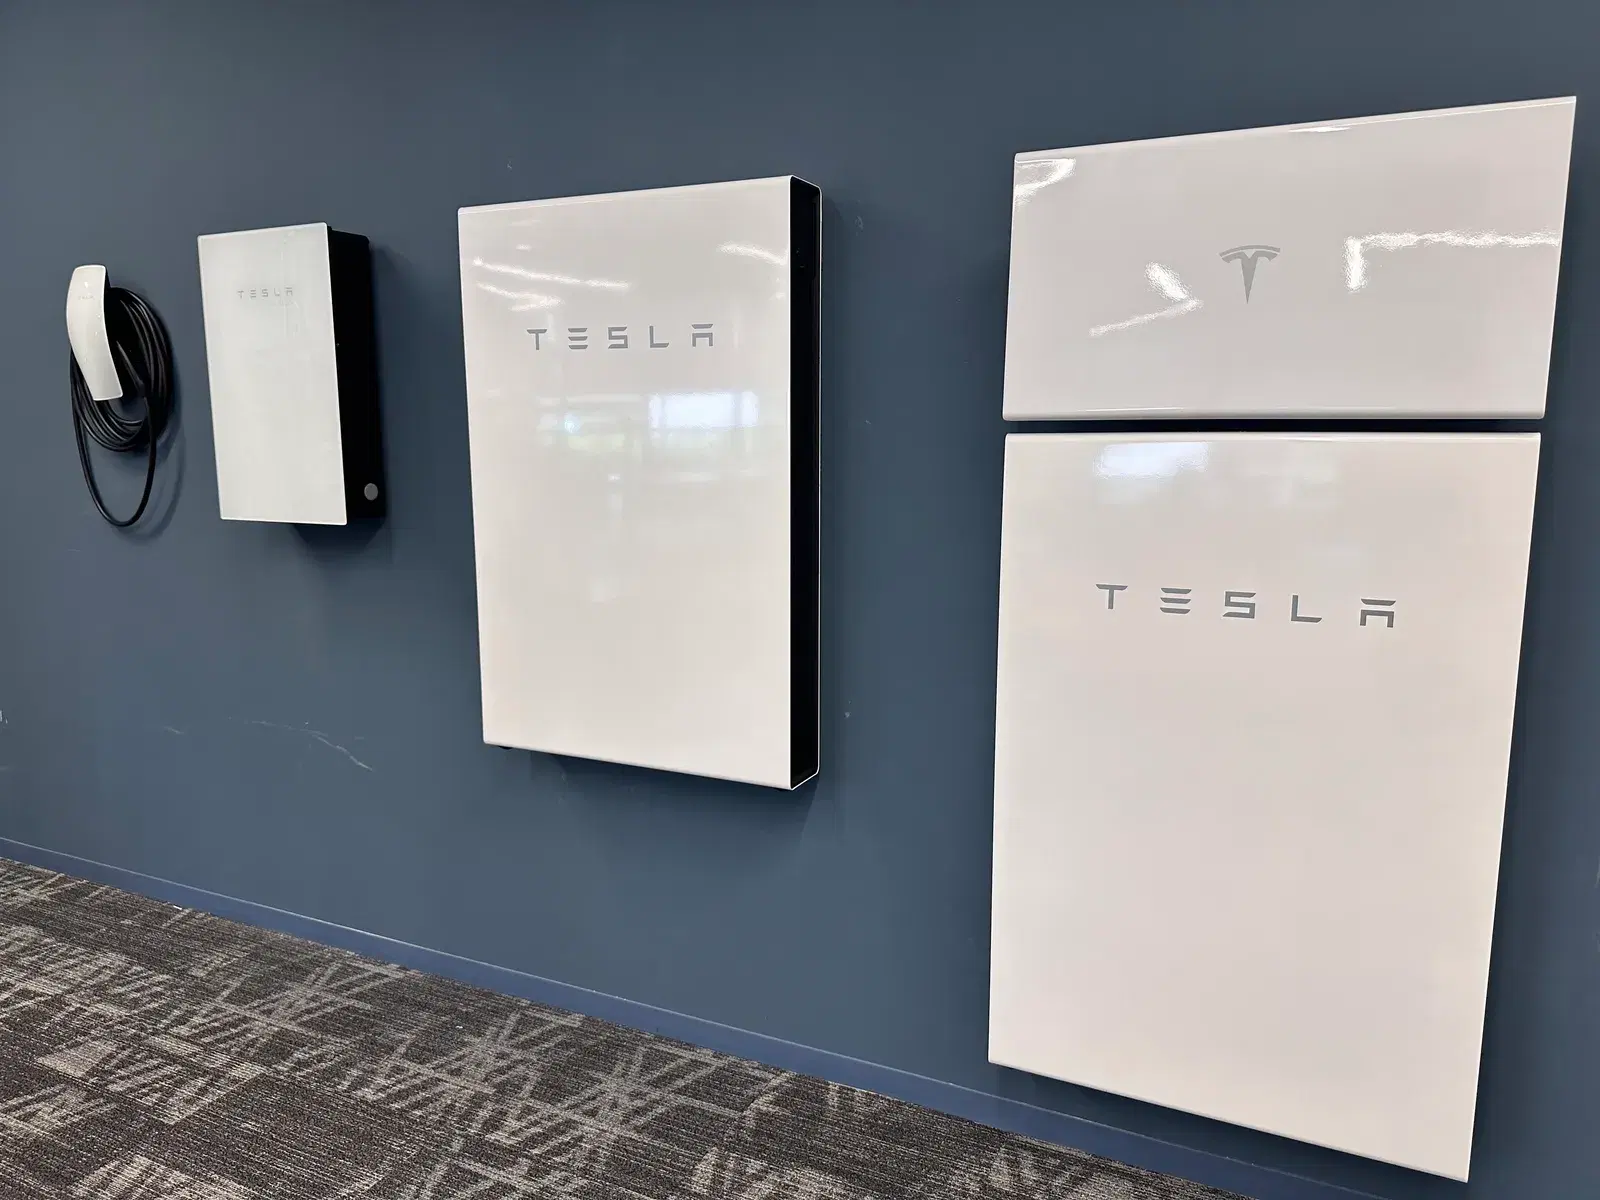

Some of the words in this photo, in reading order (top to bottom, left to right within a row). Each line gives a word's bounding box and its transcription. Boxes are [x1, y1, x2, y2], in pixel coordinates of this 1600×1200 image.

[237, 286, 293, 299] TESLA
[526, 323, 713, 350] TESLA
[1096, 584, 1396, 628] TESLA
